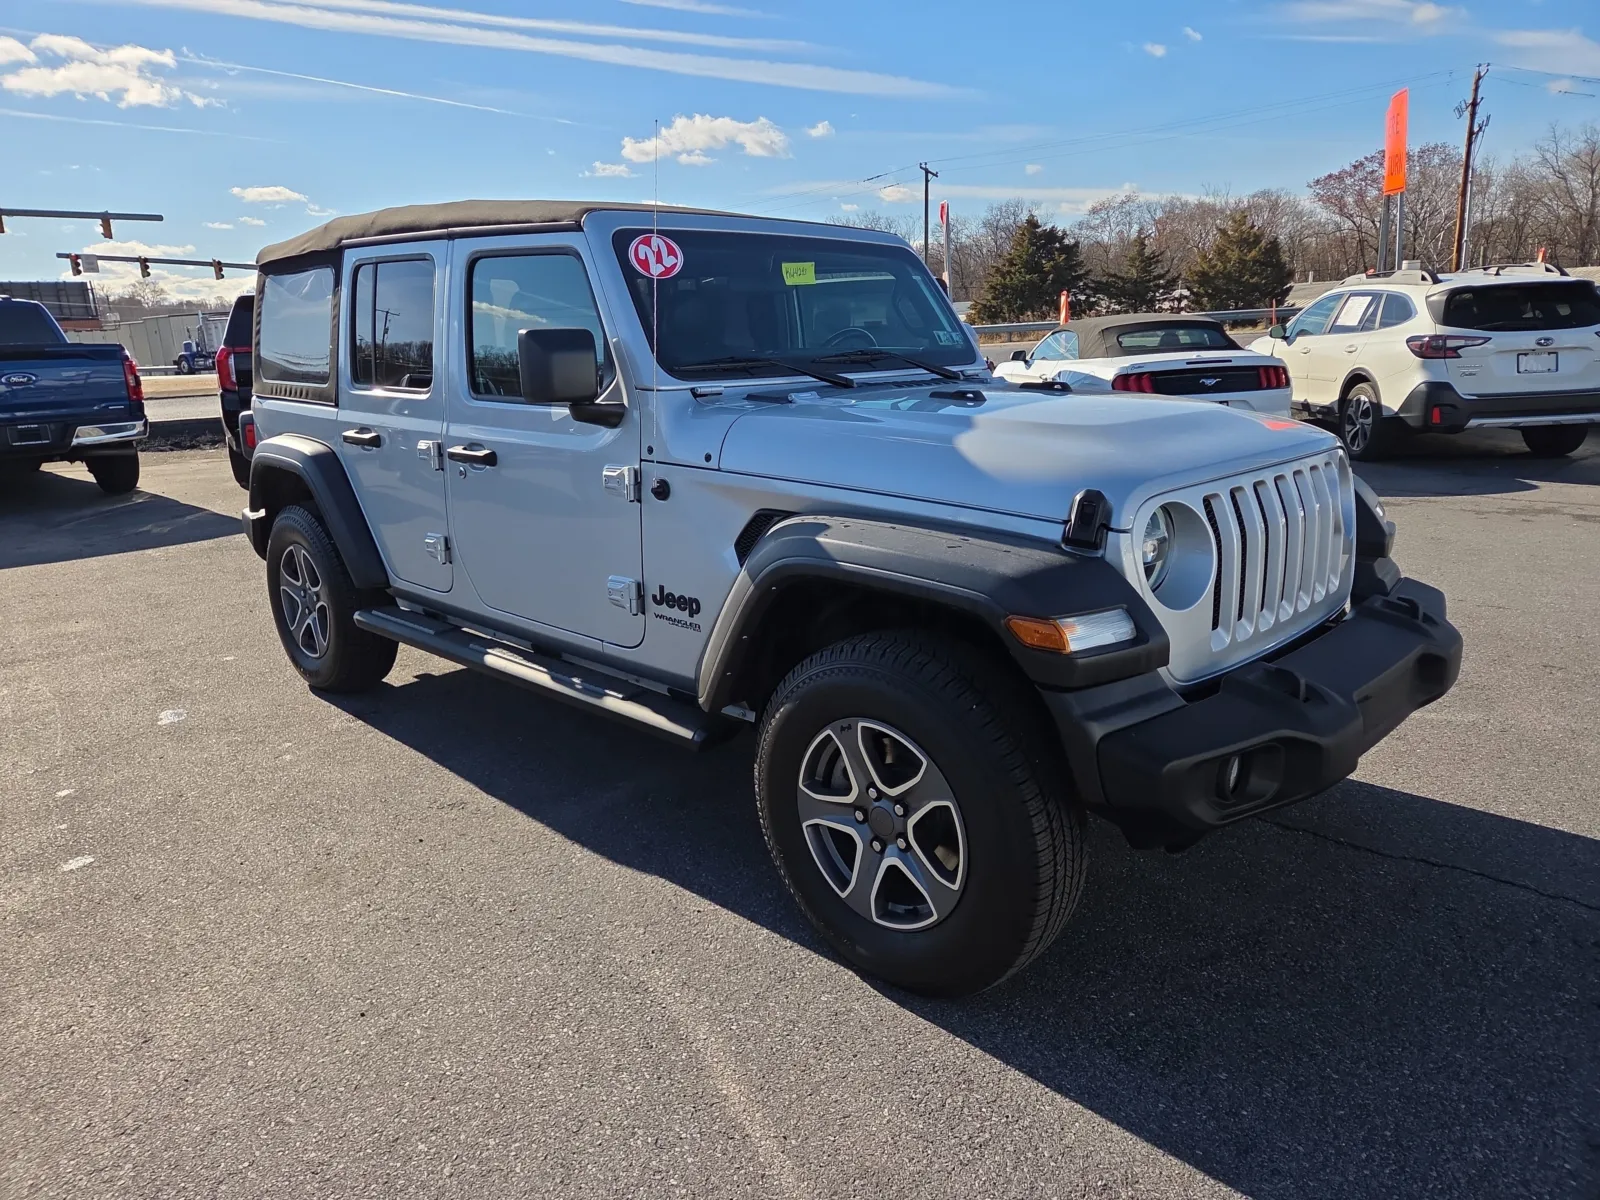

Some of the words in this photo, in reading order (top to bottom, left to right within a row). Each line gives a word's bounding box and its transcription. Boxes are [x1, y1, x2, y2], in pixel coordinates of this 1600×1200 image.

[638, 236, 678, 276] 22
[651, 584, 701, 618] Jeep
[653, 611, 701, 630] WRANGLER
